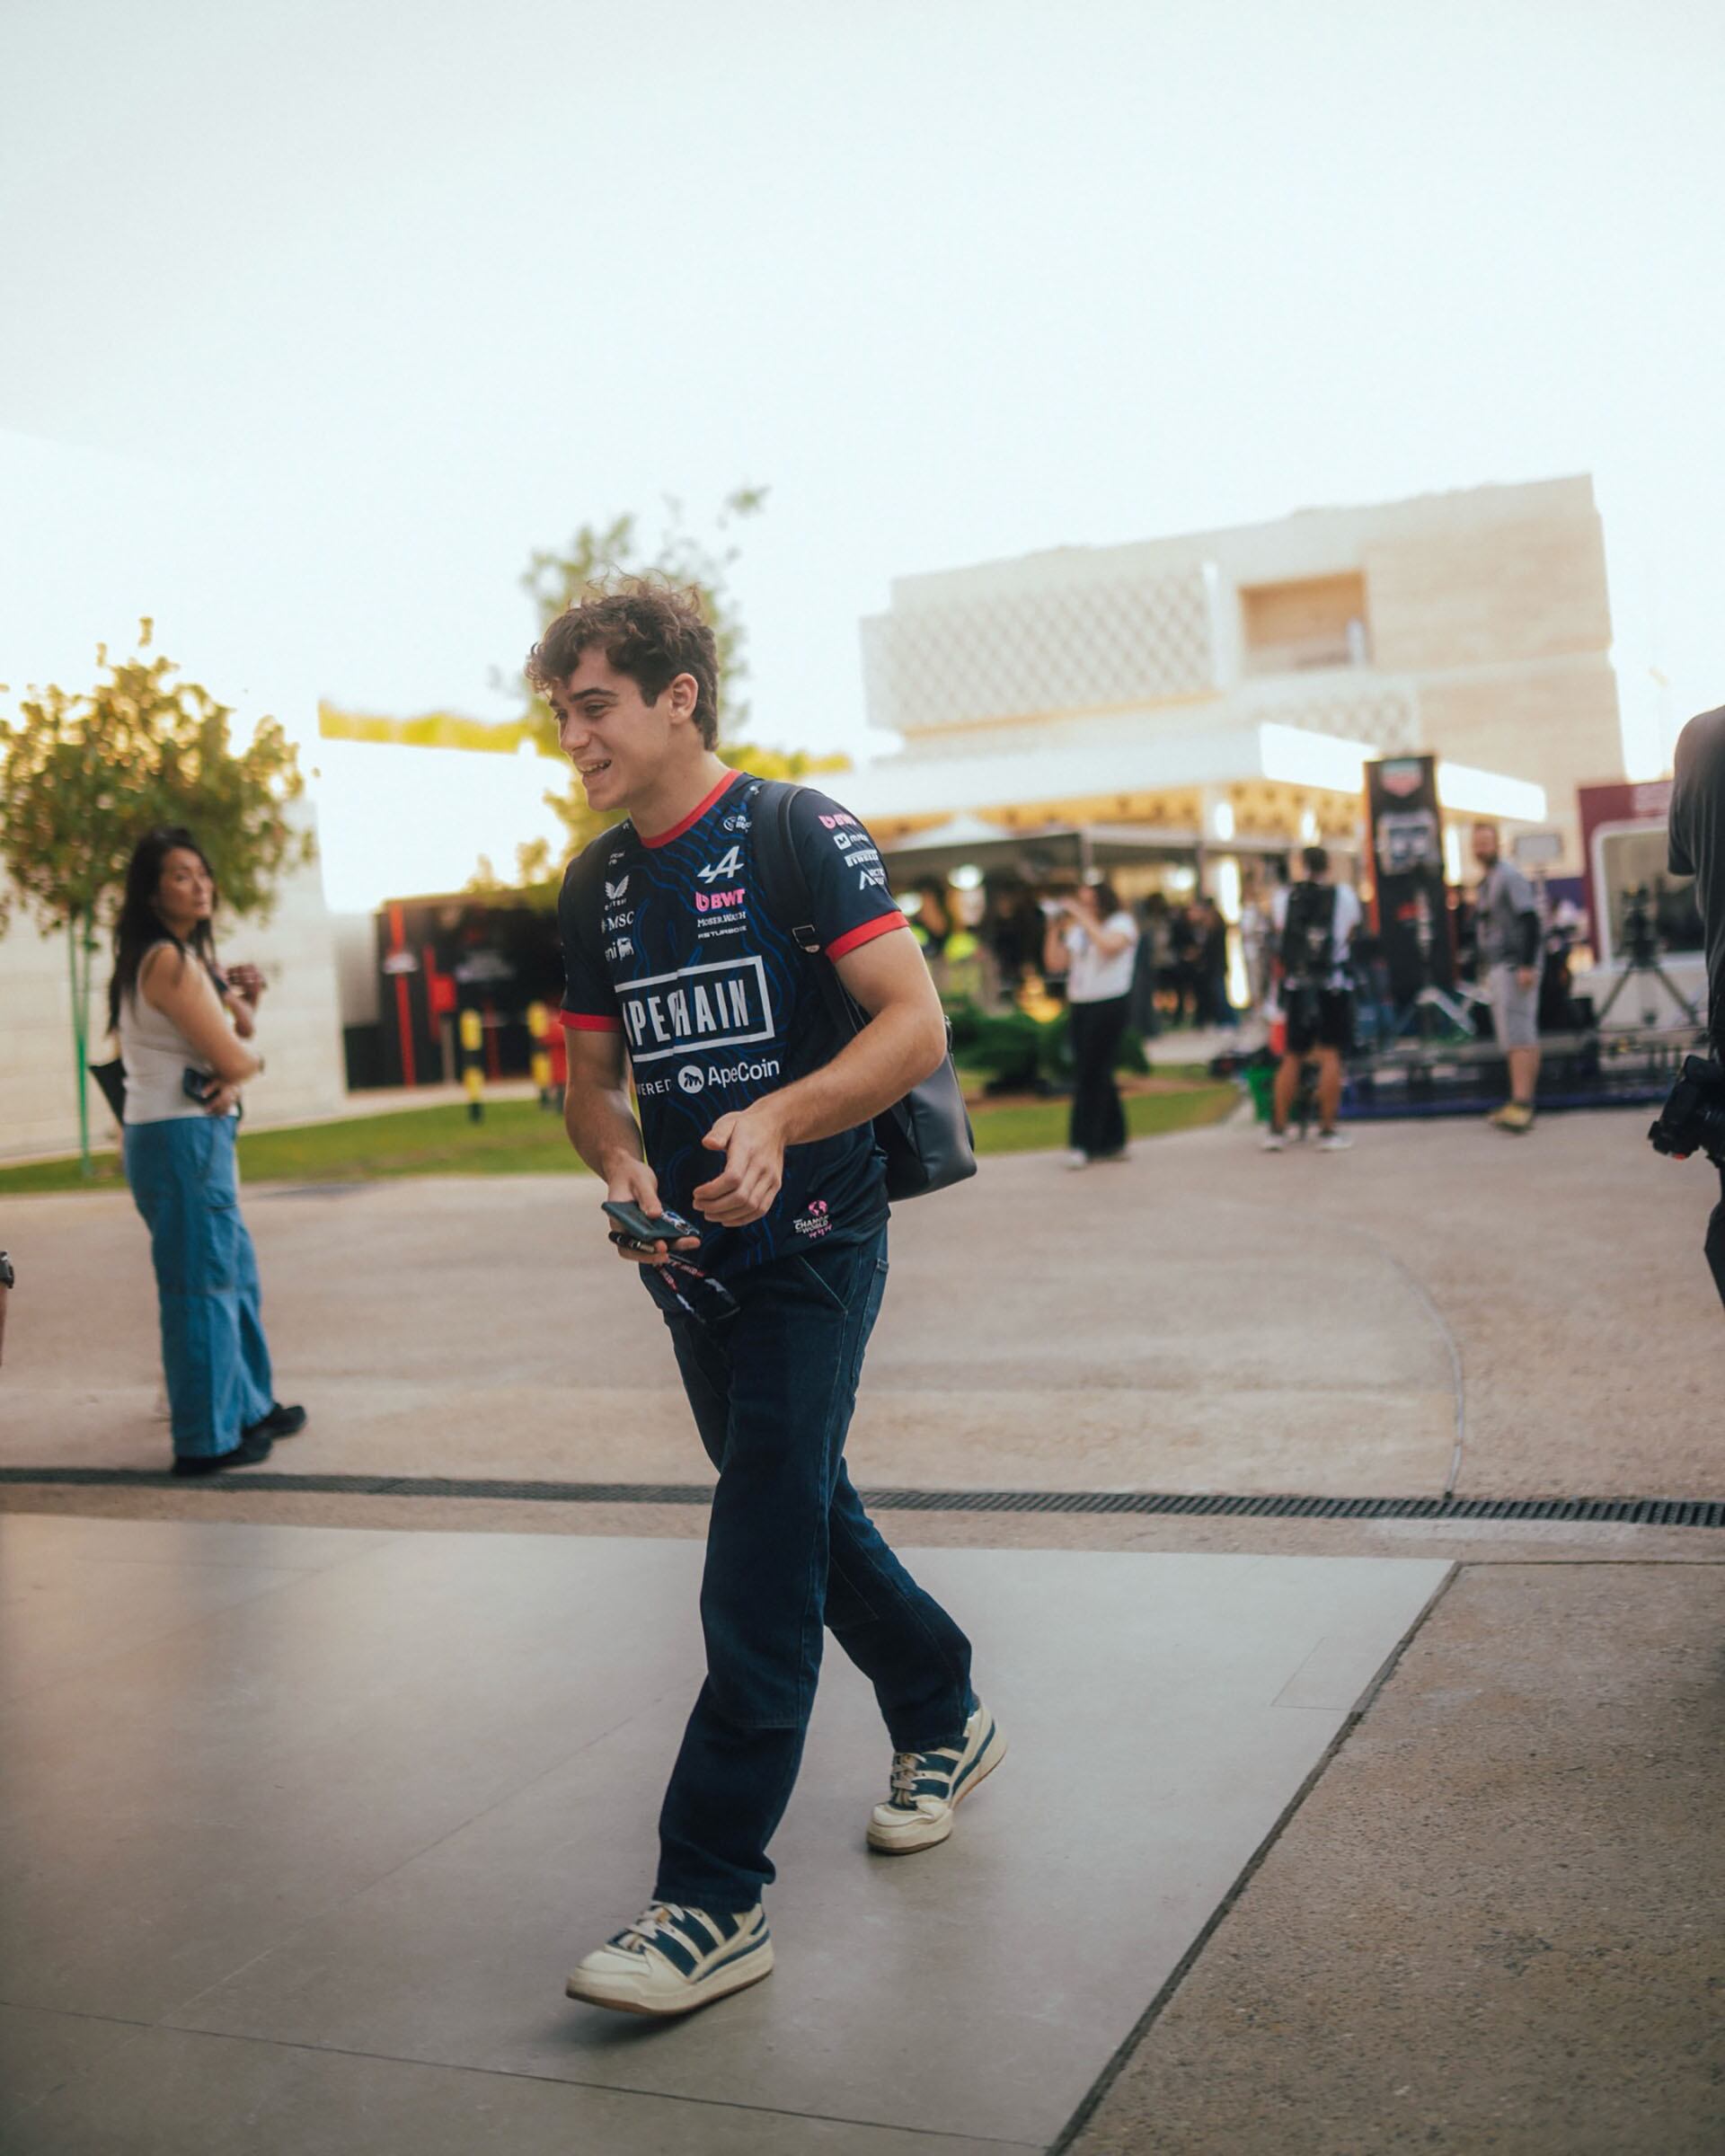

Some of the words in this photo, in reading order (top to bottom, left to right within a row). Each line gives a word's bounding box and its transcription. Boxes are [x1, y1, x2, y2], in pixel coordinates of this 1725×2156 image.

[711, 888, 746, 909] BWT
[607, 911, 634, 931] MSC
[623, 979, 749, 1047] PEHAIN
[708, 1059, 780, 1088] ApeCoin
